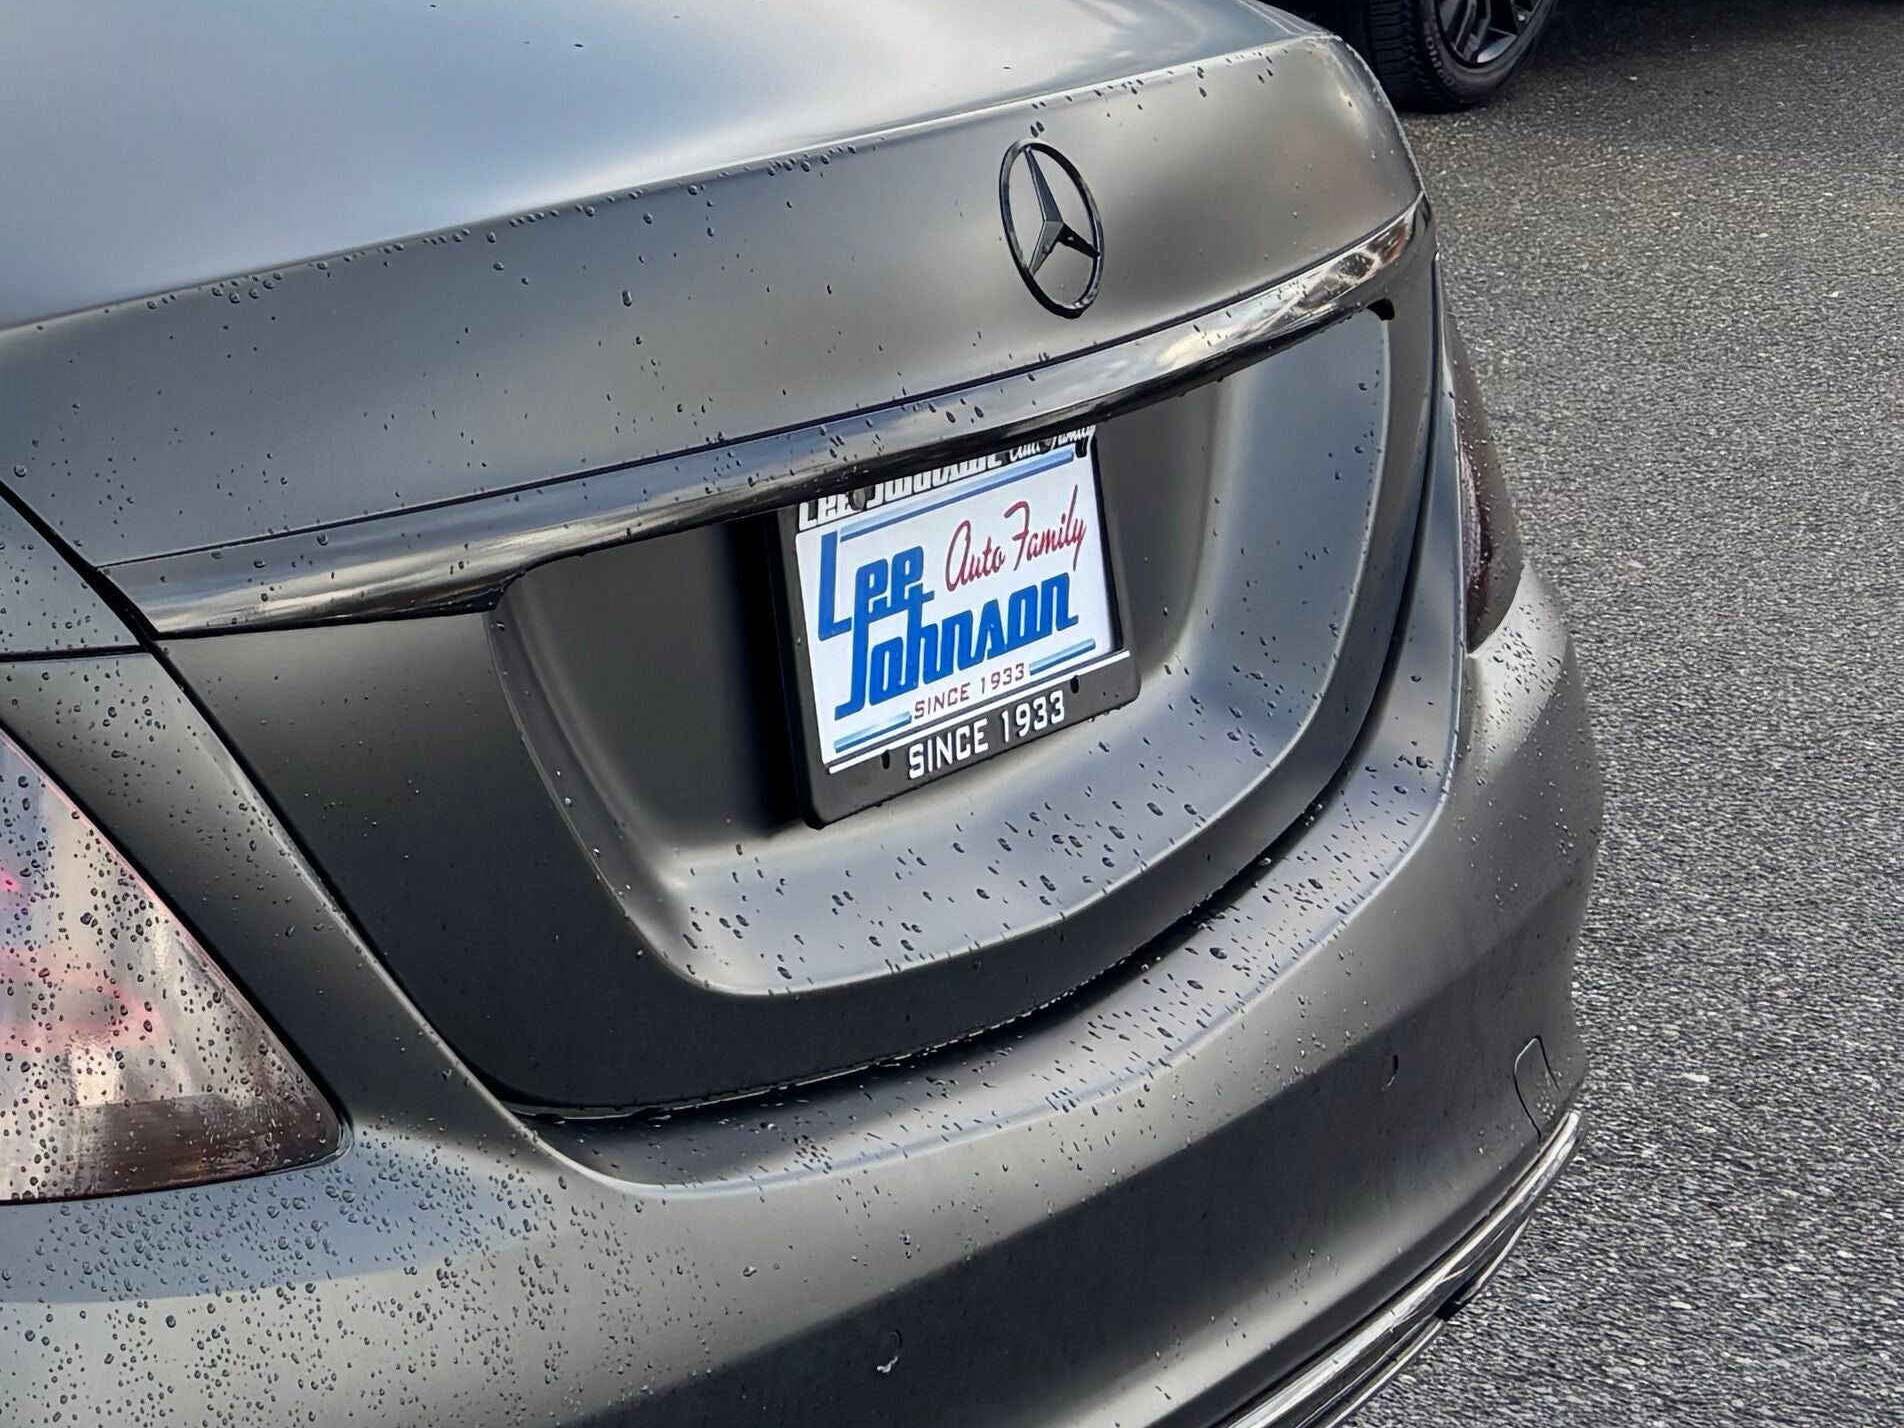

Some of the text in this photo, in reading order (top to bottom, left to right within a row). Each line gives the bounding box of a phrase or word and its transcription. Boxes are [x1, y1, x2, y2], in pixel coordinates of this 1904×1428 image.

[817, 483, 1087, 642] Lee Auto Family
[833, 571, 1080, 722] Johnson
[913, 662, 1026, 720] SINCE 1933
[907, 689, 1066, 780] SINCE 1933
